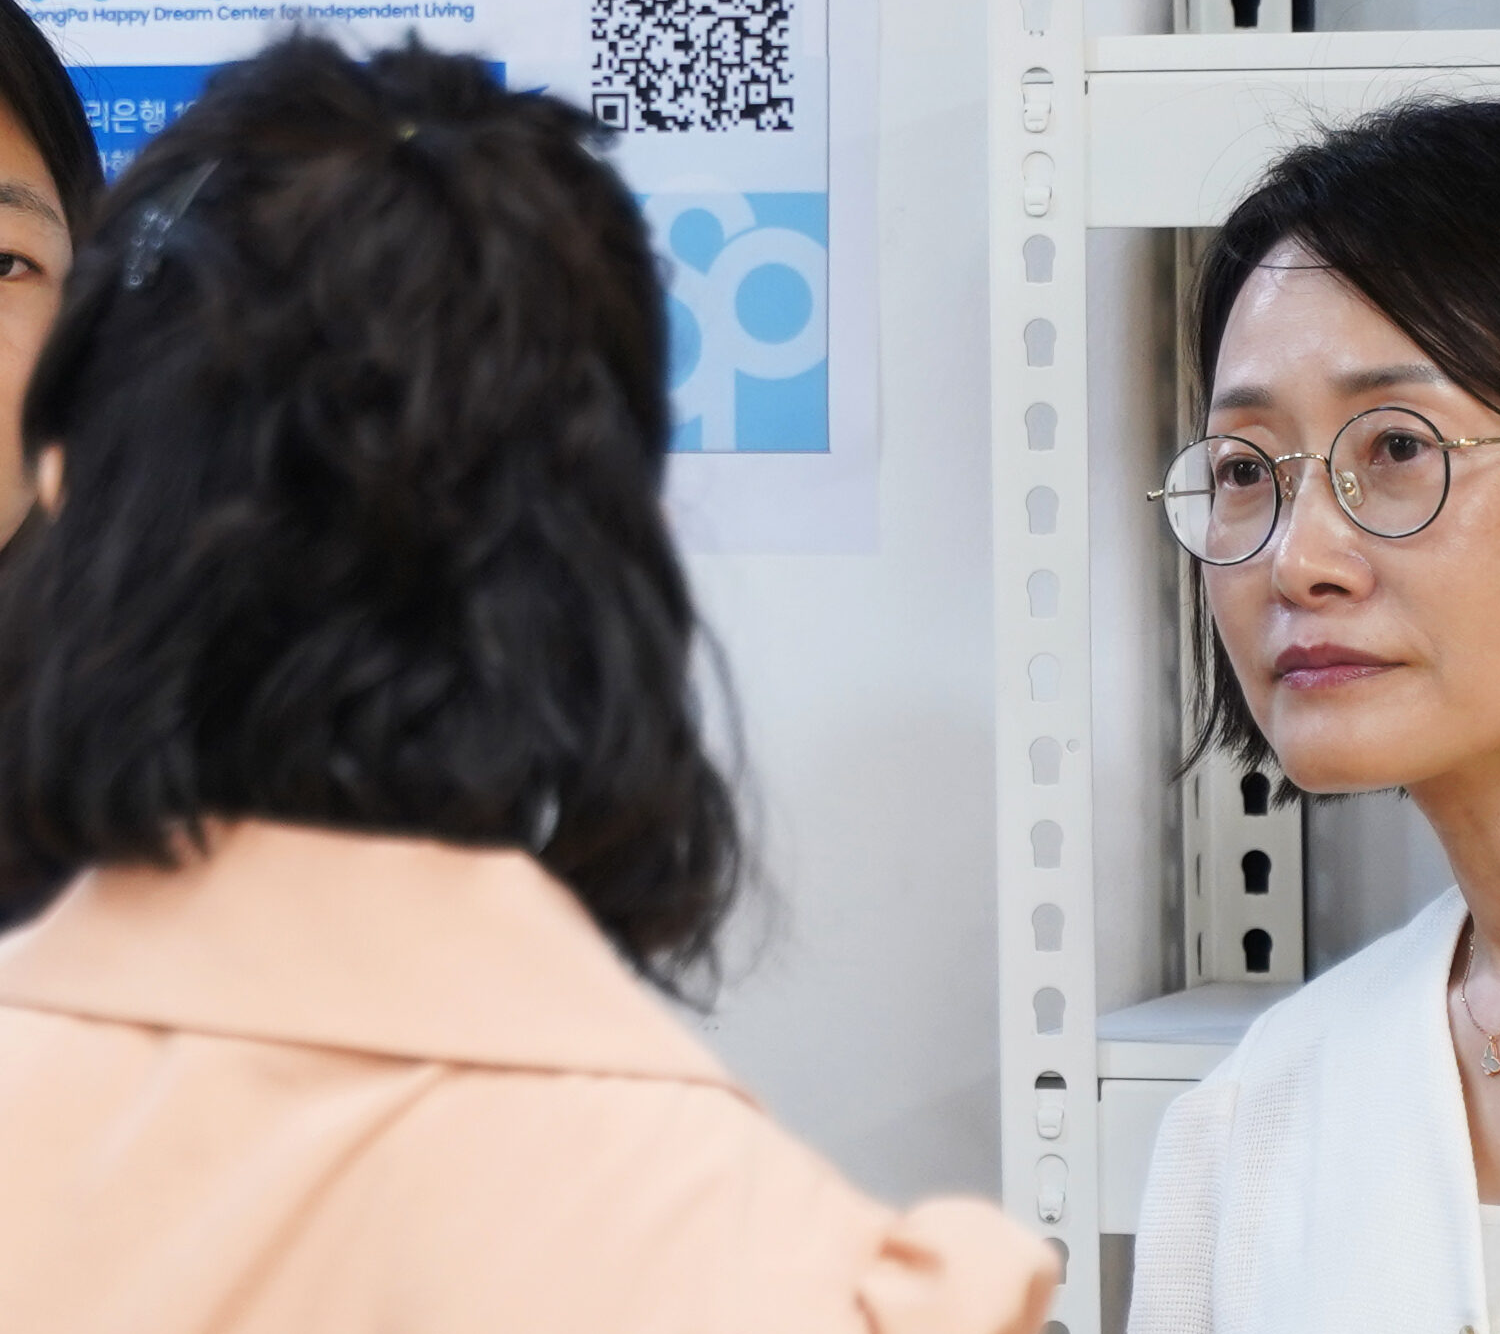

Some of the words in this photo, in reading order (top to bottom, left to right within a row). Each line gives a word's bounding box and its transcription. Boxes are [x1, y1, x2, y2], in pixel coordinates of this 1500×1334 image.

[93, 7, 150, 27] Happy
[155, 6, 214, 22] Dream
[218, 4, 275, 21] Center
[307, 2, 421, 21] Independent
[424, 1, 476, 23] Living
